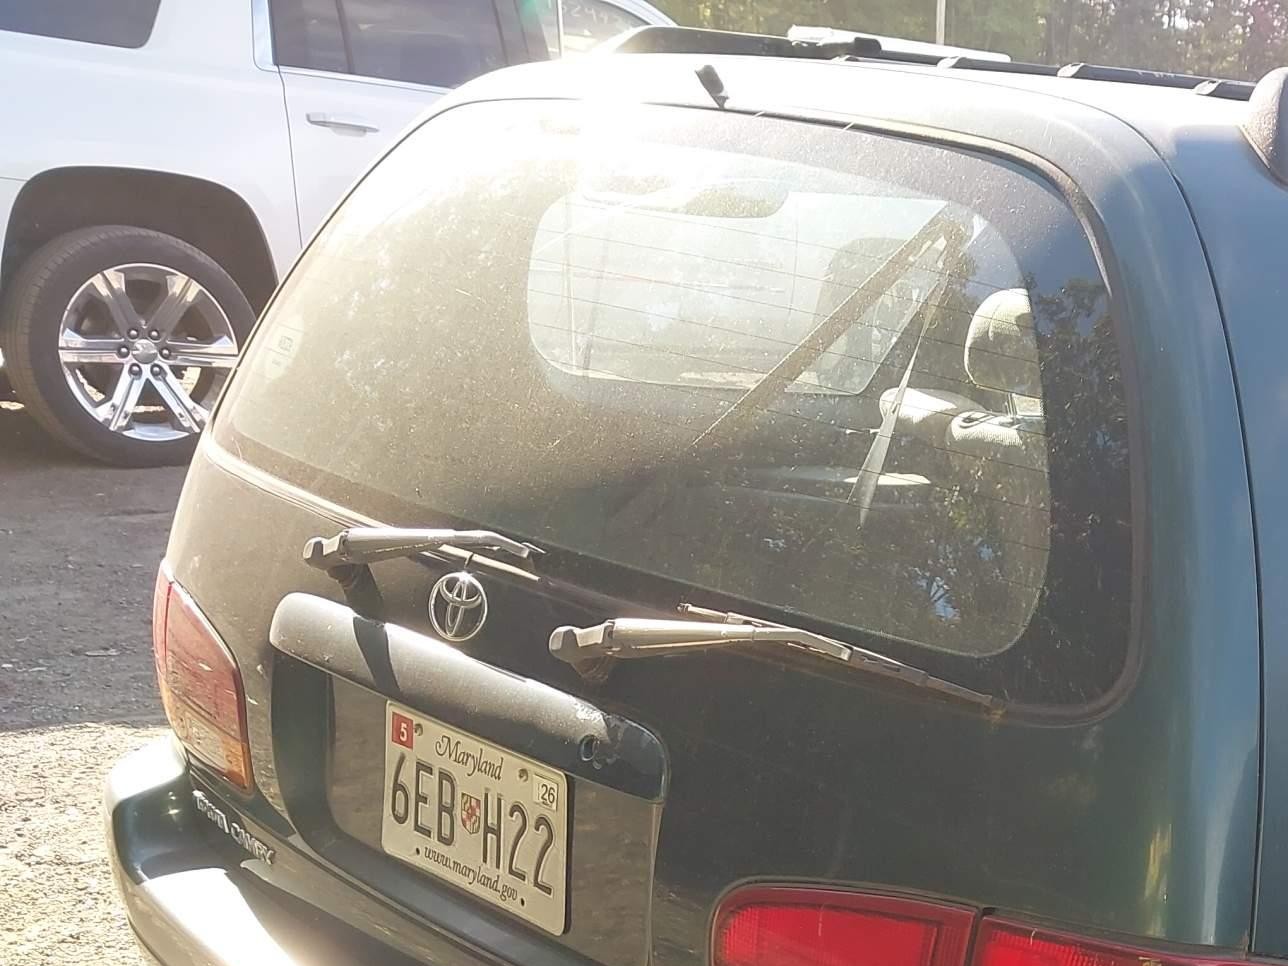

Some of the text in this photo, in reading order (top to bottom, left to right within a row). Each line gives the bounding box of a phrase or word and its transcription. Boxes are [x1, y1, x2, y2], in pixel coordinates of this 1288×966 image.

[399, 721, 408, 742] 5
[435, 735, 504, 780] Maryland
[540, 783, 556, 805] 26
[424, 846, 519, 902] www.maryland.gov
